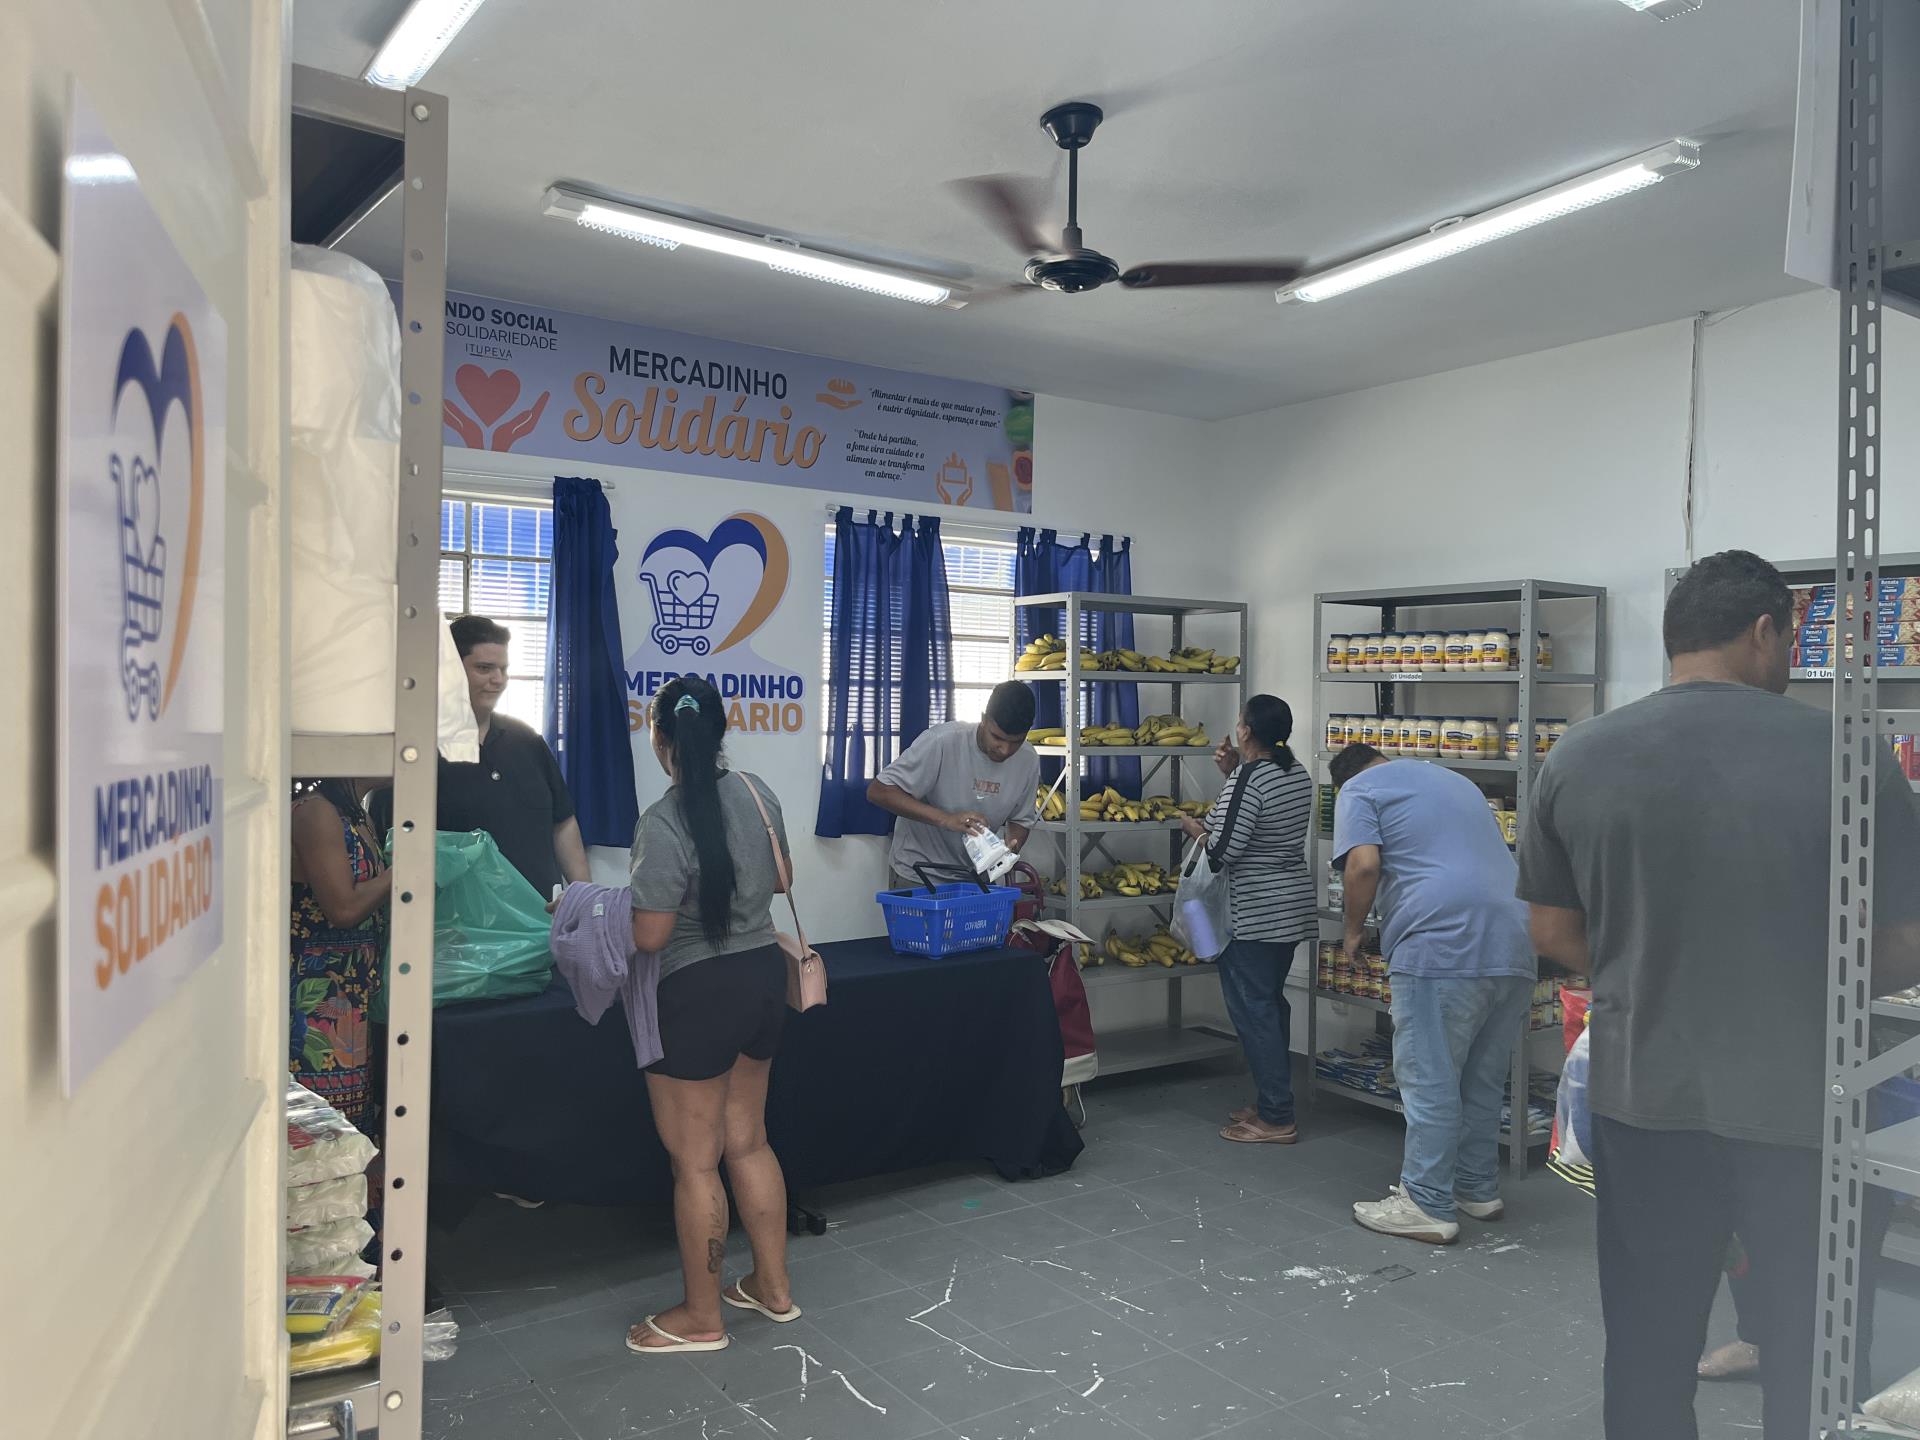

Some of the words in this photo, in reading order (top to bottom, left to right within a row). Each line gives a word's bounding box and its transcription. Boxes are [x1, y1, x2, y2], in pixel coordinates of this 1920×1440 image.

[445, 300, 485, 321] NDO
[491, 308, 558, 334] SOCIAL
[446, 321, 558, 351] SOLIDARIEDADE
[465, 343, 513, 359] ITUPEVA
[609, 345, 787, 400] MERCADINHO
[883, 404, 904, 414] nutrir
[904, 406, 942, 420] dignidade,
[942, 413, 975, 427] esperança
[913, 396, 930, 406] mais
[941, 401, 953, 411] que
[954, 404, 975, 413] matar
[979, 406, 996, 417] fome
[563, 371, 827, 469] Solidário
[851, 441, 869, 453] fome
[870, 444, 885, 454] vira
[885, 446, 914, 458] cuidado
[878, 432, 888, 443] há
[888, 435, 919, 447] partilha,
[846, 454, 878, 465] alimento
[879, 459, 886, 467] se
[887, 459, 925, 472] transforma
[865, 470, 876, 478] em
[624, 671, 804, 700] MEDINHO
[1807, 670, 1817, 678] 01
[629, 693, 804, 733] SÁRIO
[94, 763, 212, 872] MERCADINHO
[94, 833, 213, 991] SOLIDÁRIO
